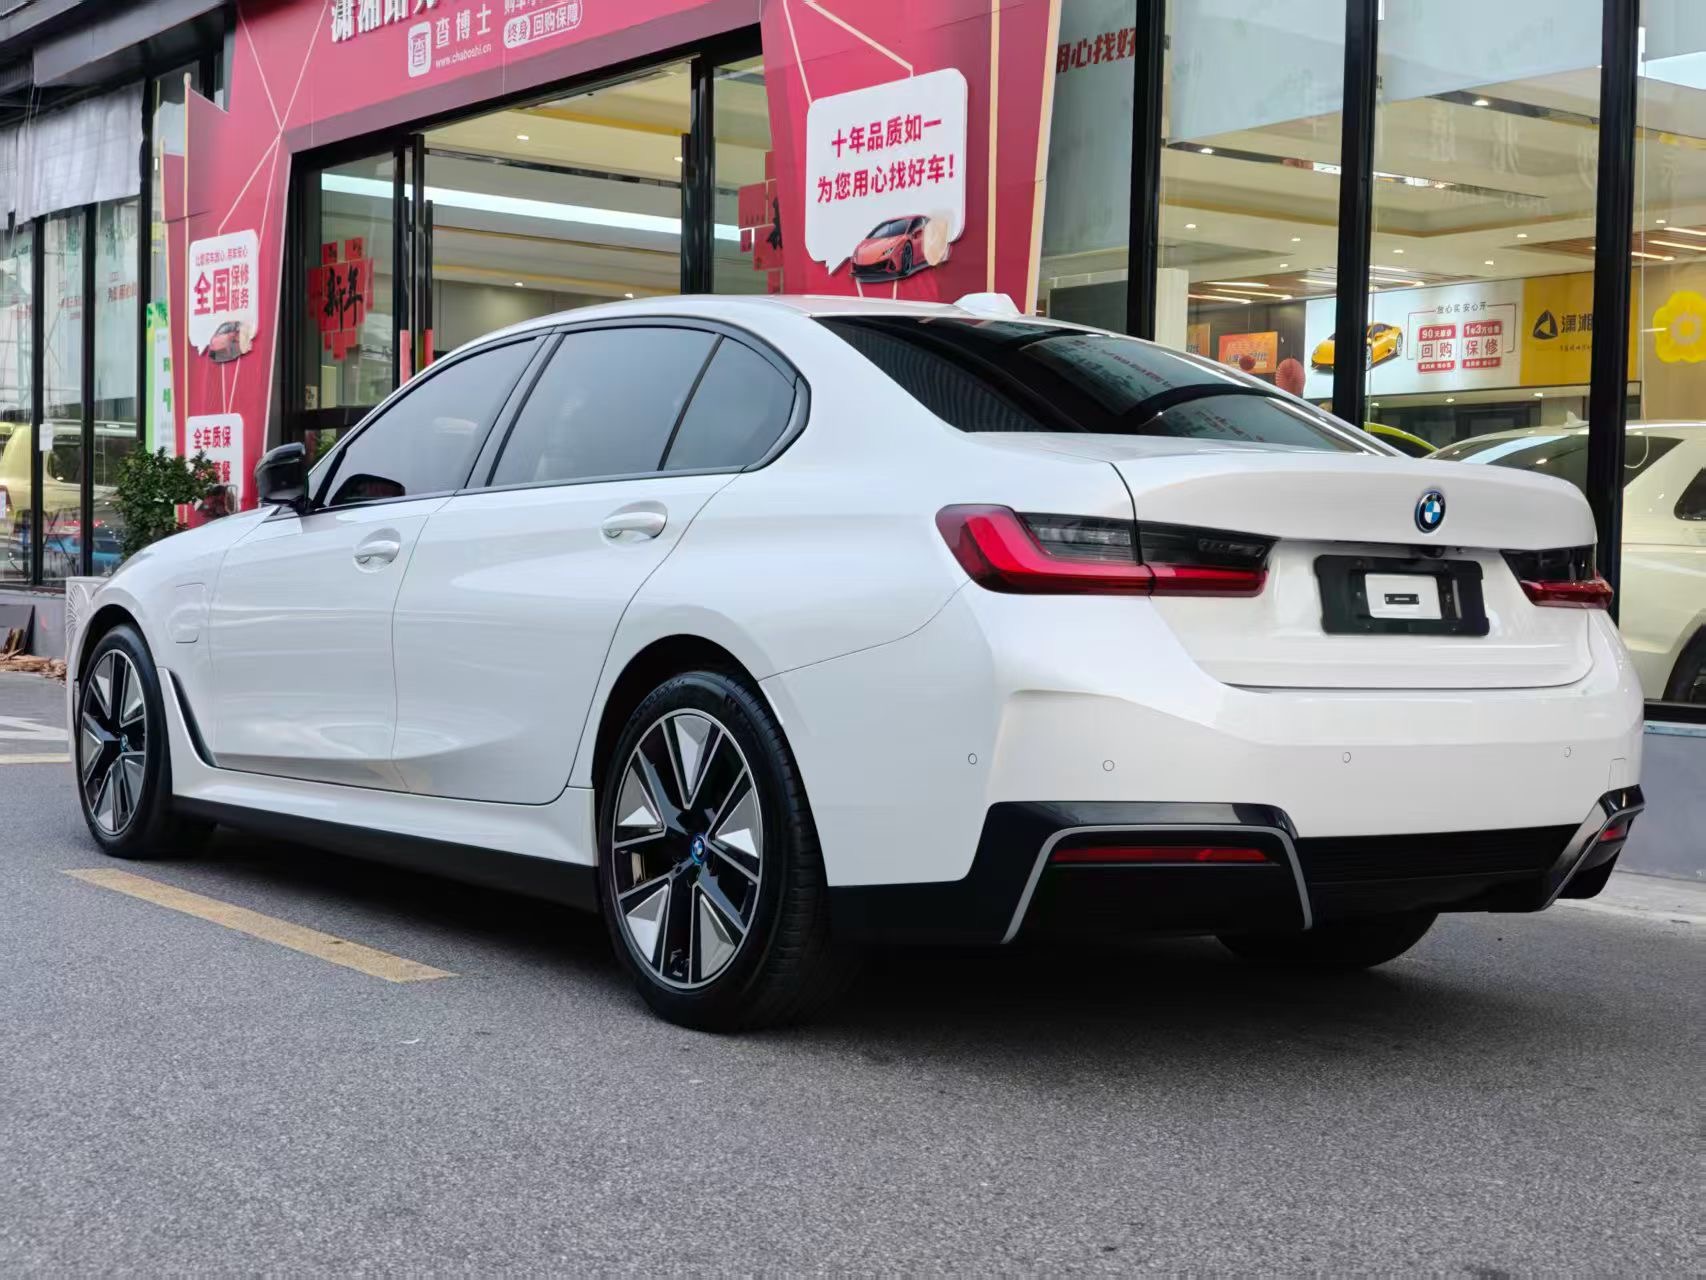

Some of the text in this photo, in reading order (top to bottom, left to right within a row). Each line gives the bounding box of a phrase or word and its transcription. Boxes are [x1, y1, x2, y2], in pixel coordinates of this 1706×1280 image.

[436, 4, 492, 49] 查博士
[507, 20, 528, 43] 终身
[533, 4, 579, 36] 回购保障
[831, 114, 942, 158] 十年品质如一
[193, 267, 231, 315] 全国
[231, 263, 249, 288] 保修
[1421, 342, 1452, 359] 回购
[1466, 338, 1499, 356] 保修
[193, 426, 232, 449] 全车质保
